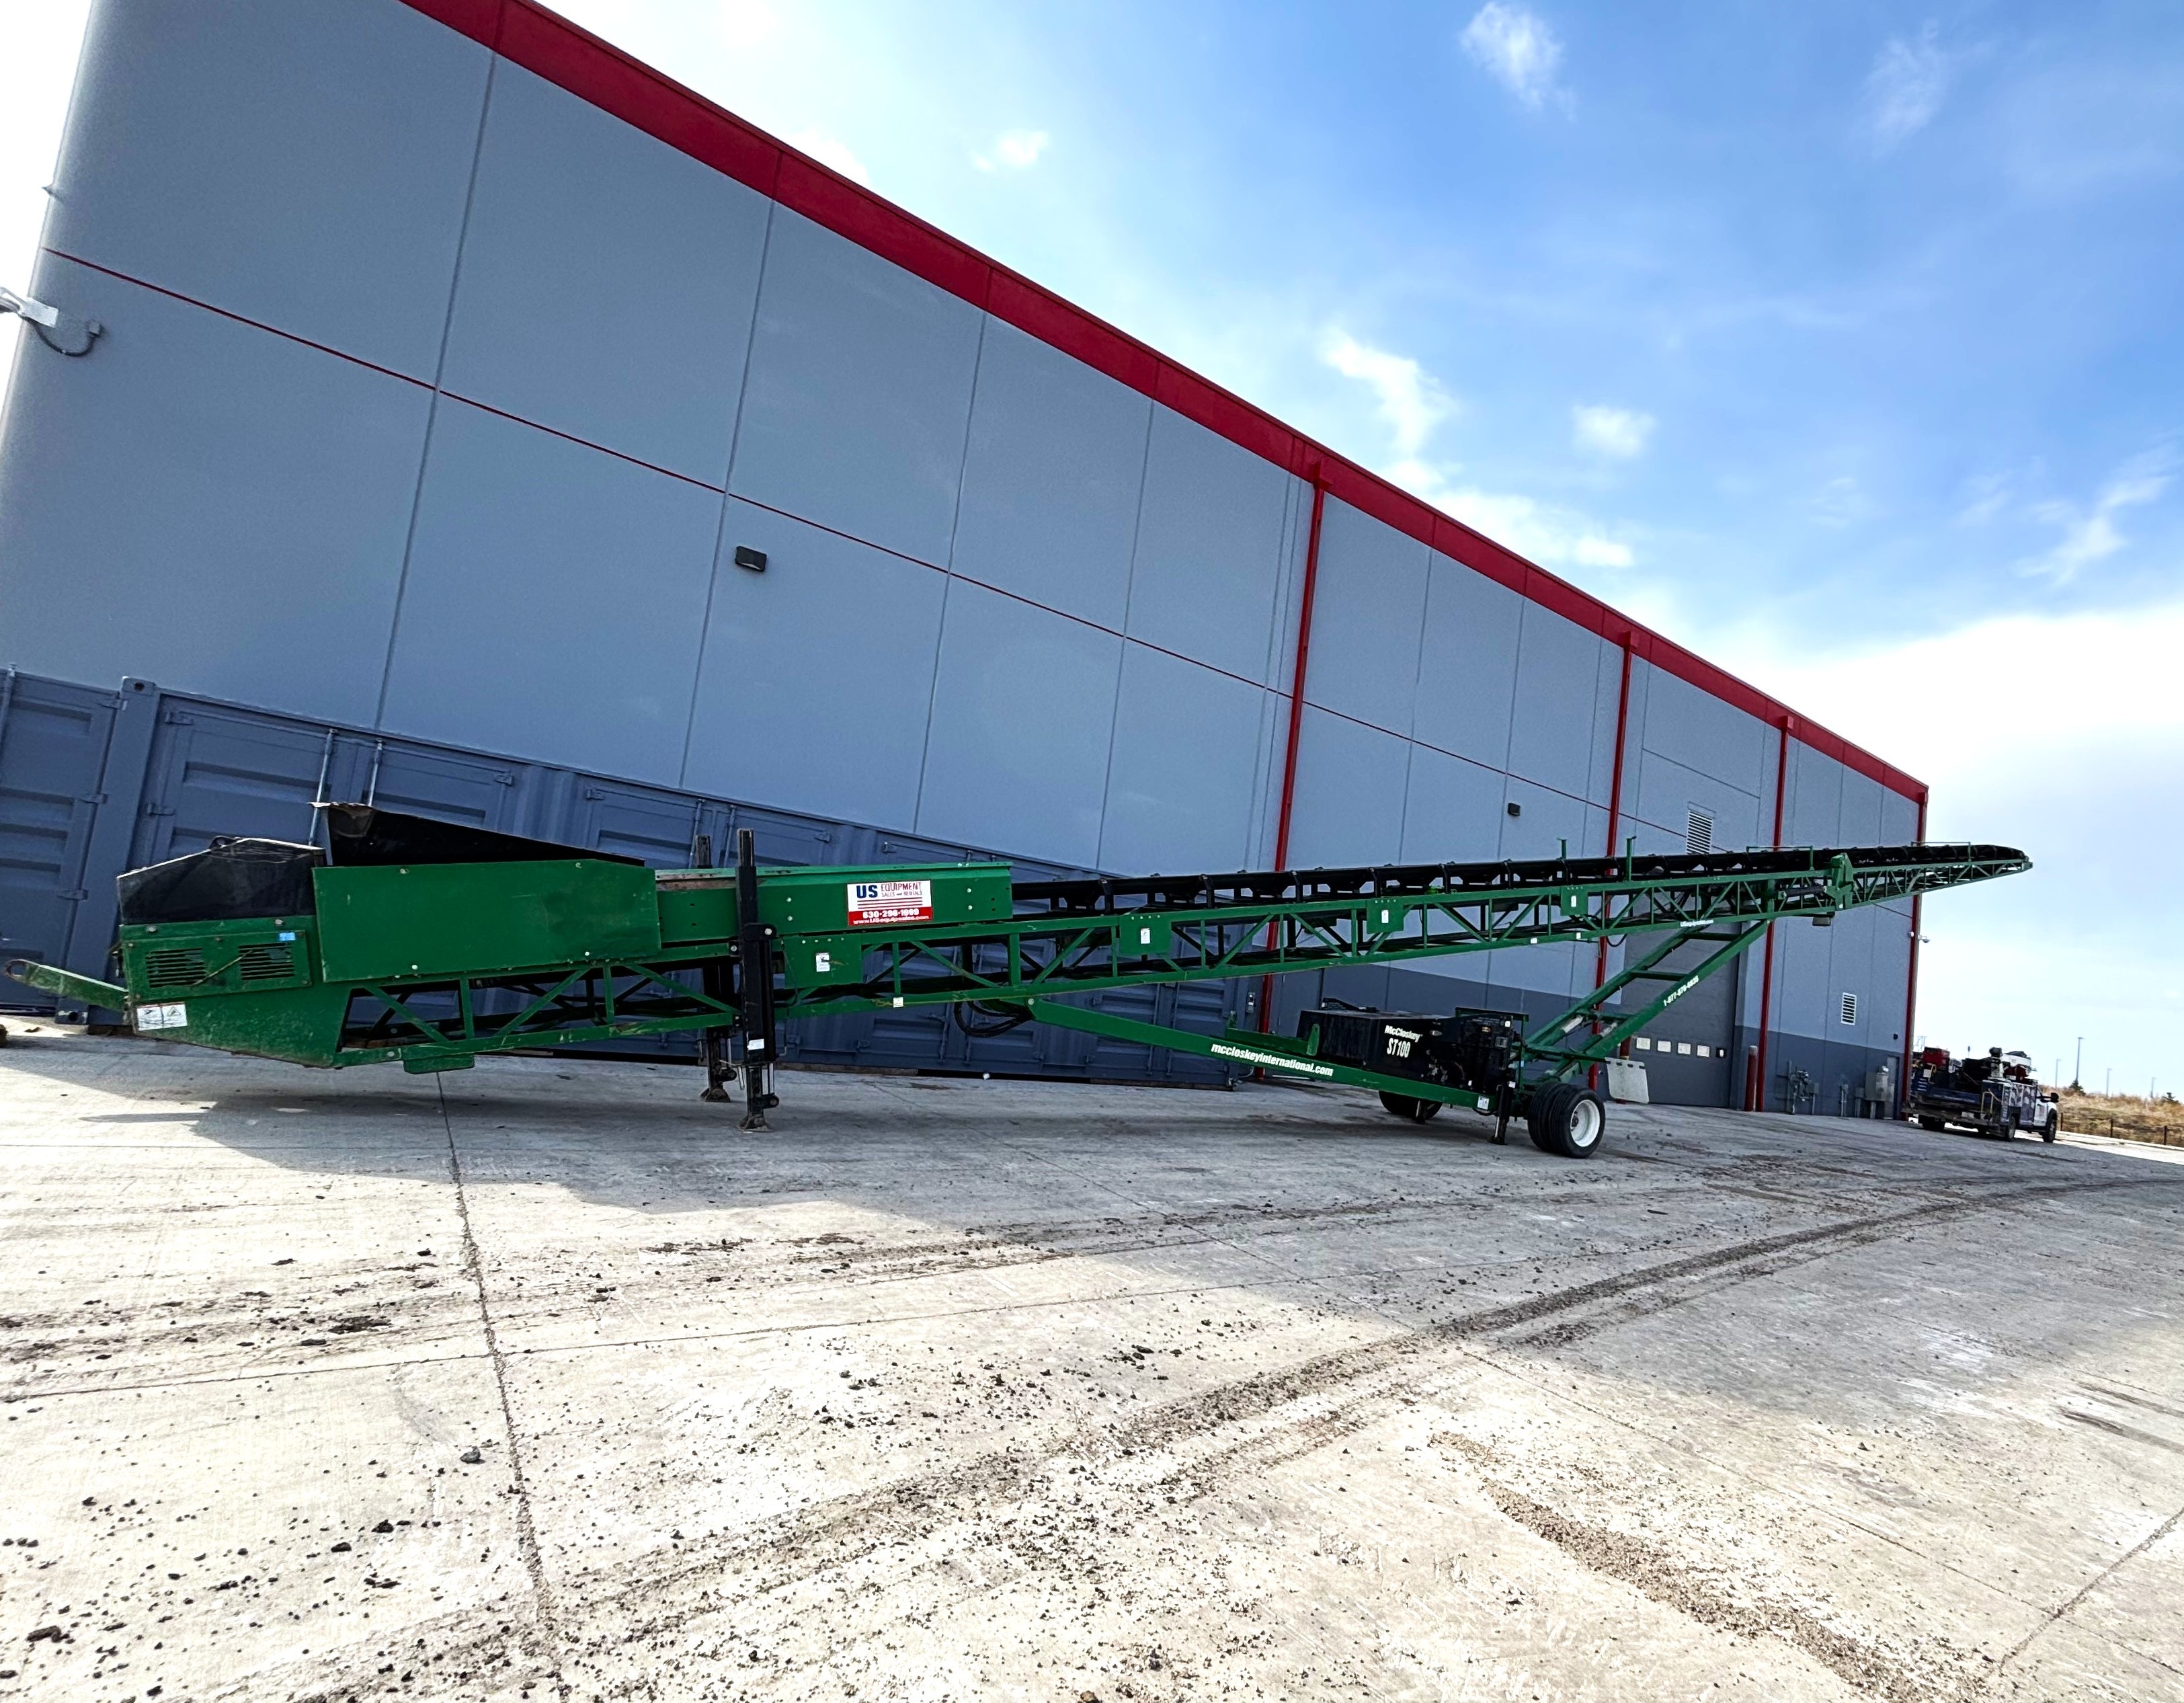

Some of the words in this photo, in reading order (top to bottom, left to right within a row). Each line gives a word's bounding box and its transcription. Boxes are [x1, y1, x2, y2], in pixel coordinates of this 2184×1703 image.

[856, 885, 878, 898] US
[881, 882, 922, 892] EQUIPMENT
[1384, 1025, 1420, 1043] McCloskey
[1387, 1037, 1411, 1058] ST100
[1211, 1042, 1334, 1076] mccloskeyinternational.com
